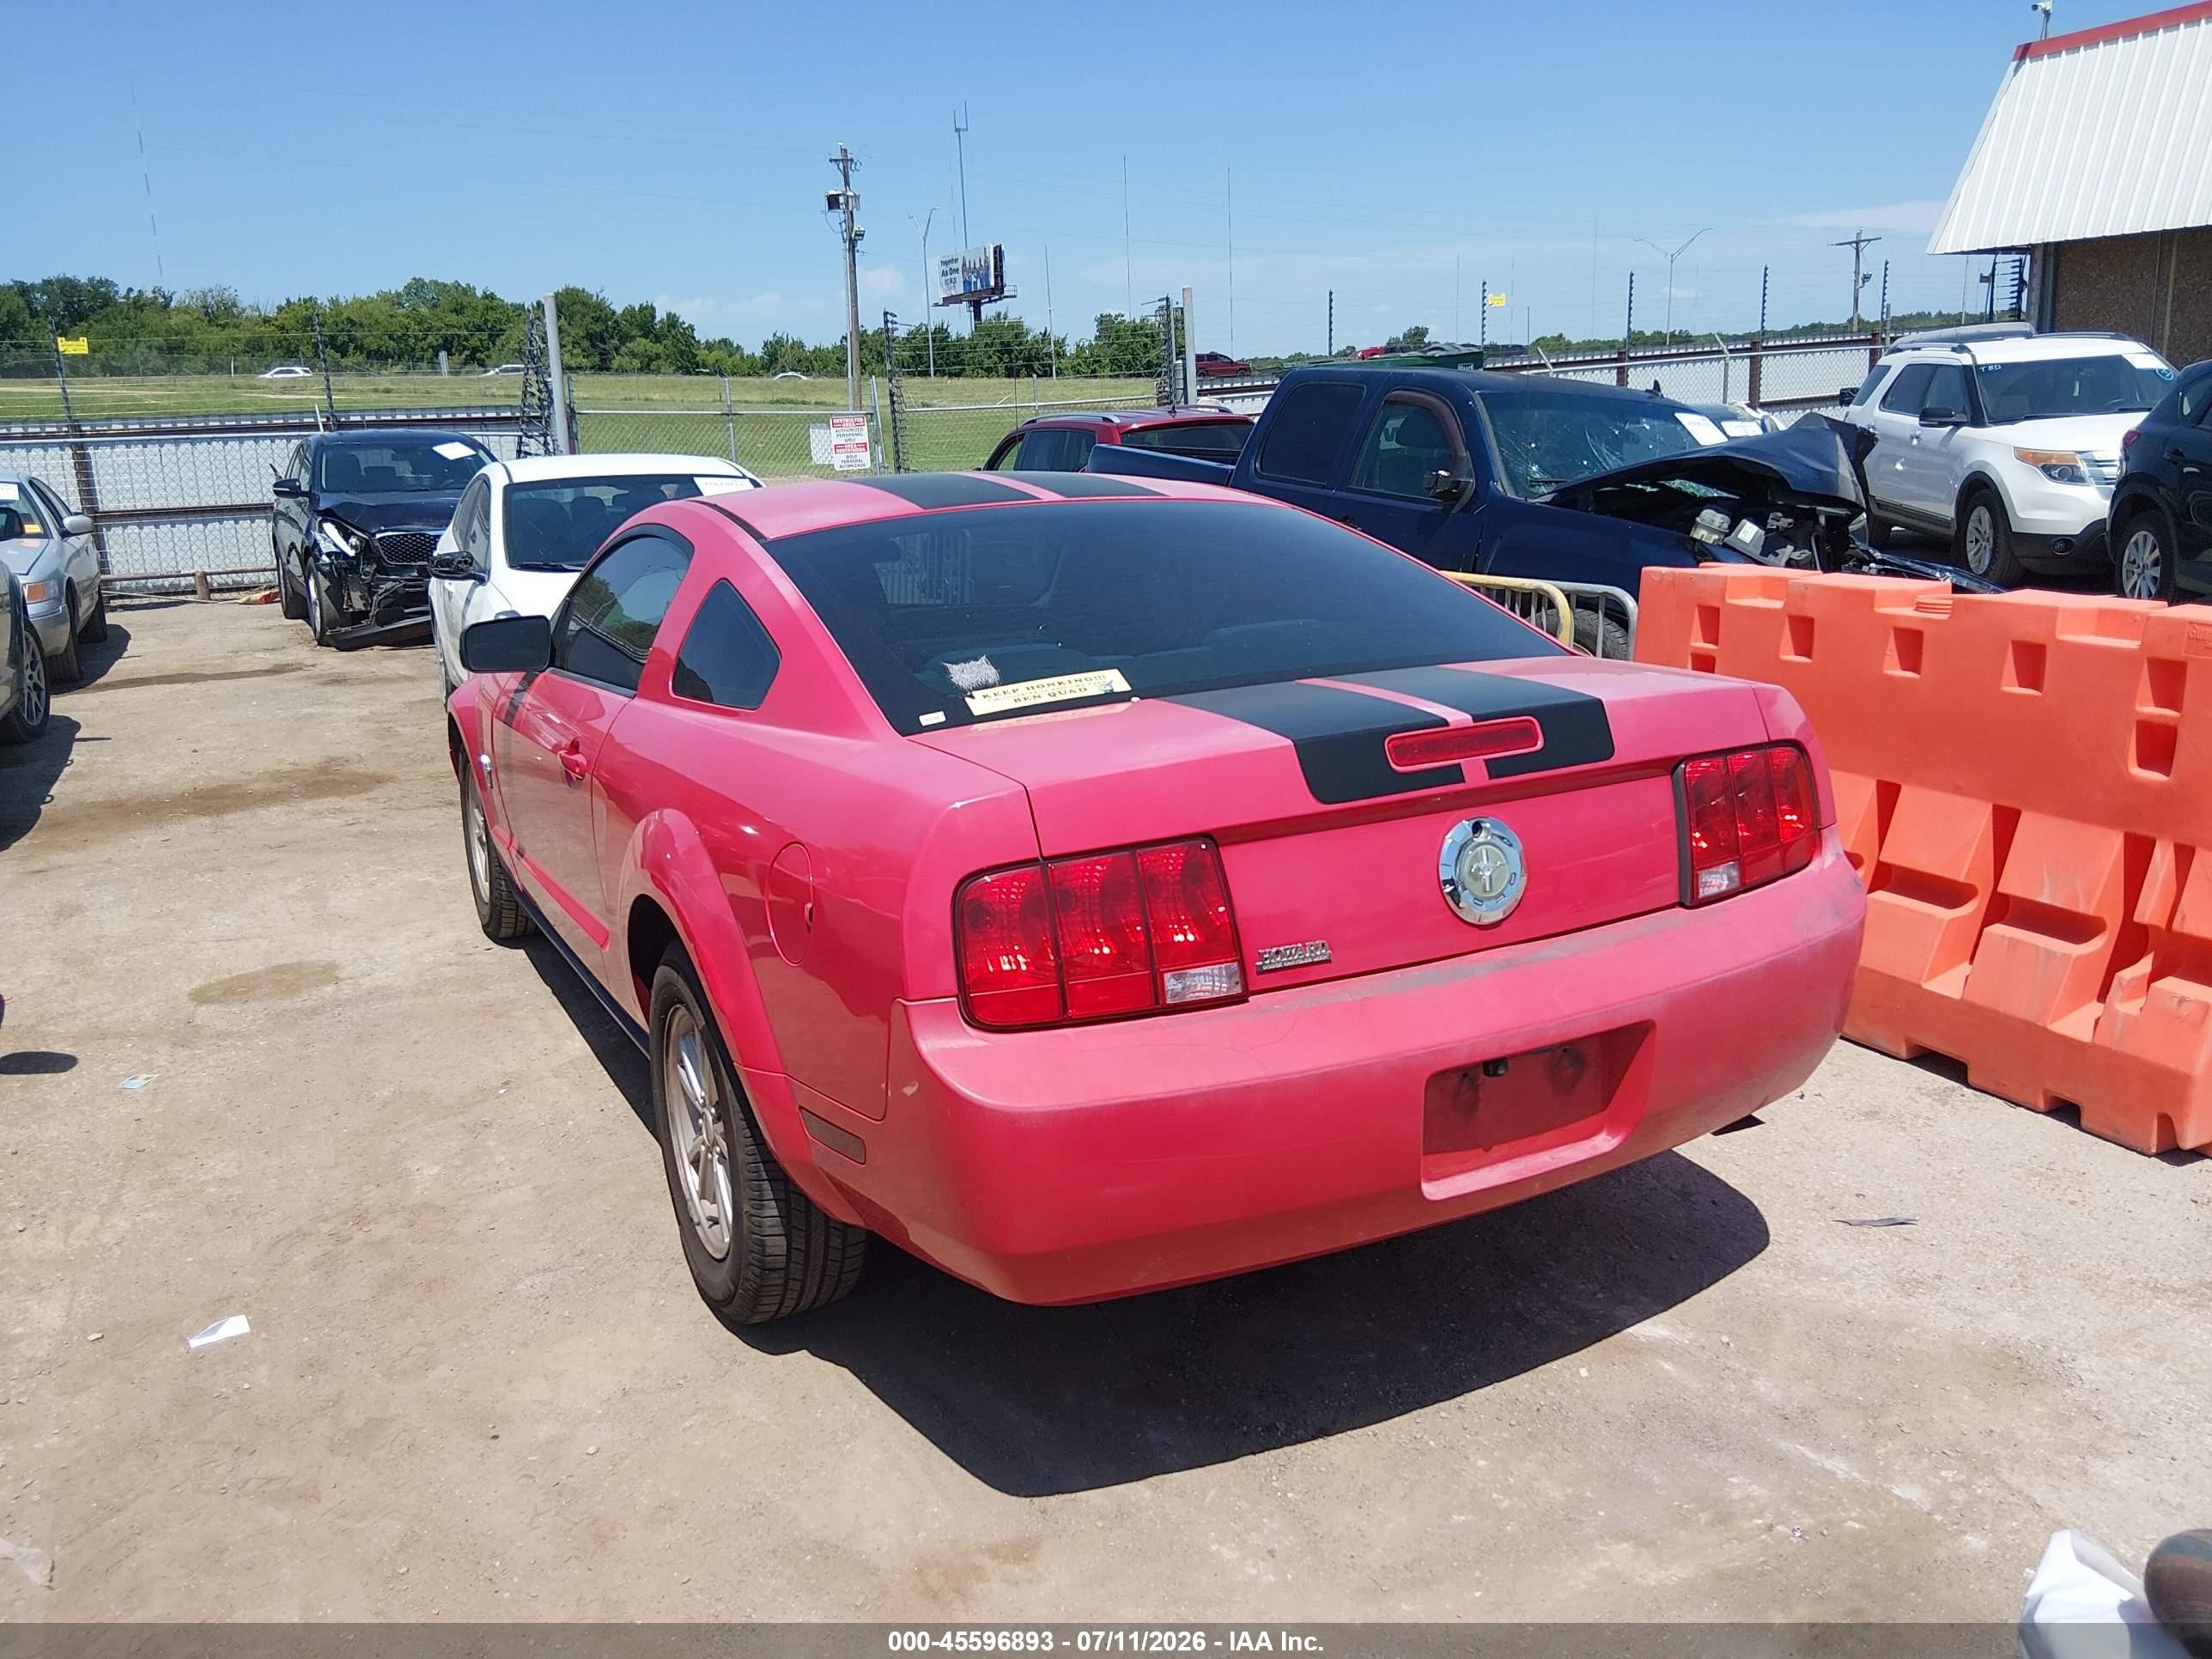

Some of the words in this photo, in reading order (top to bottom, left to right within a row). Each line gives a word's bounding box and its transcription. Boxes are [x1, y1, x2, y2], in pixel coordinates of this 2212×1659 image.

[941, 269, 948, 277] As
[949, 267, 960, 276] One
[982, 688, 1019, 699] KEEP
[1025, 675, 1107, 691] HONKING!!!
